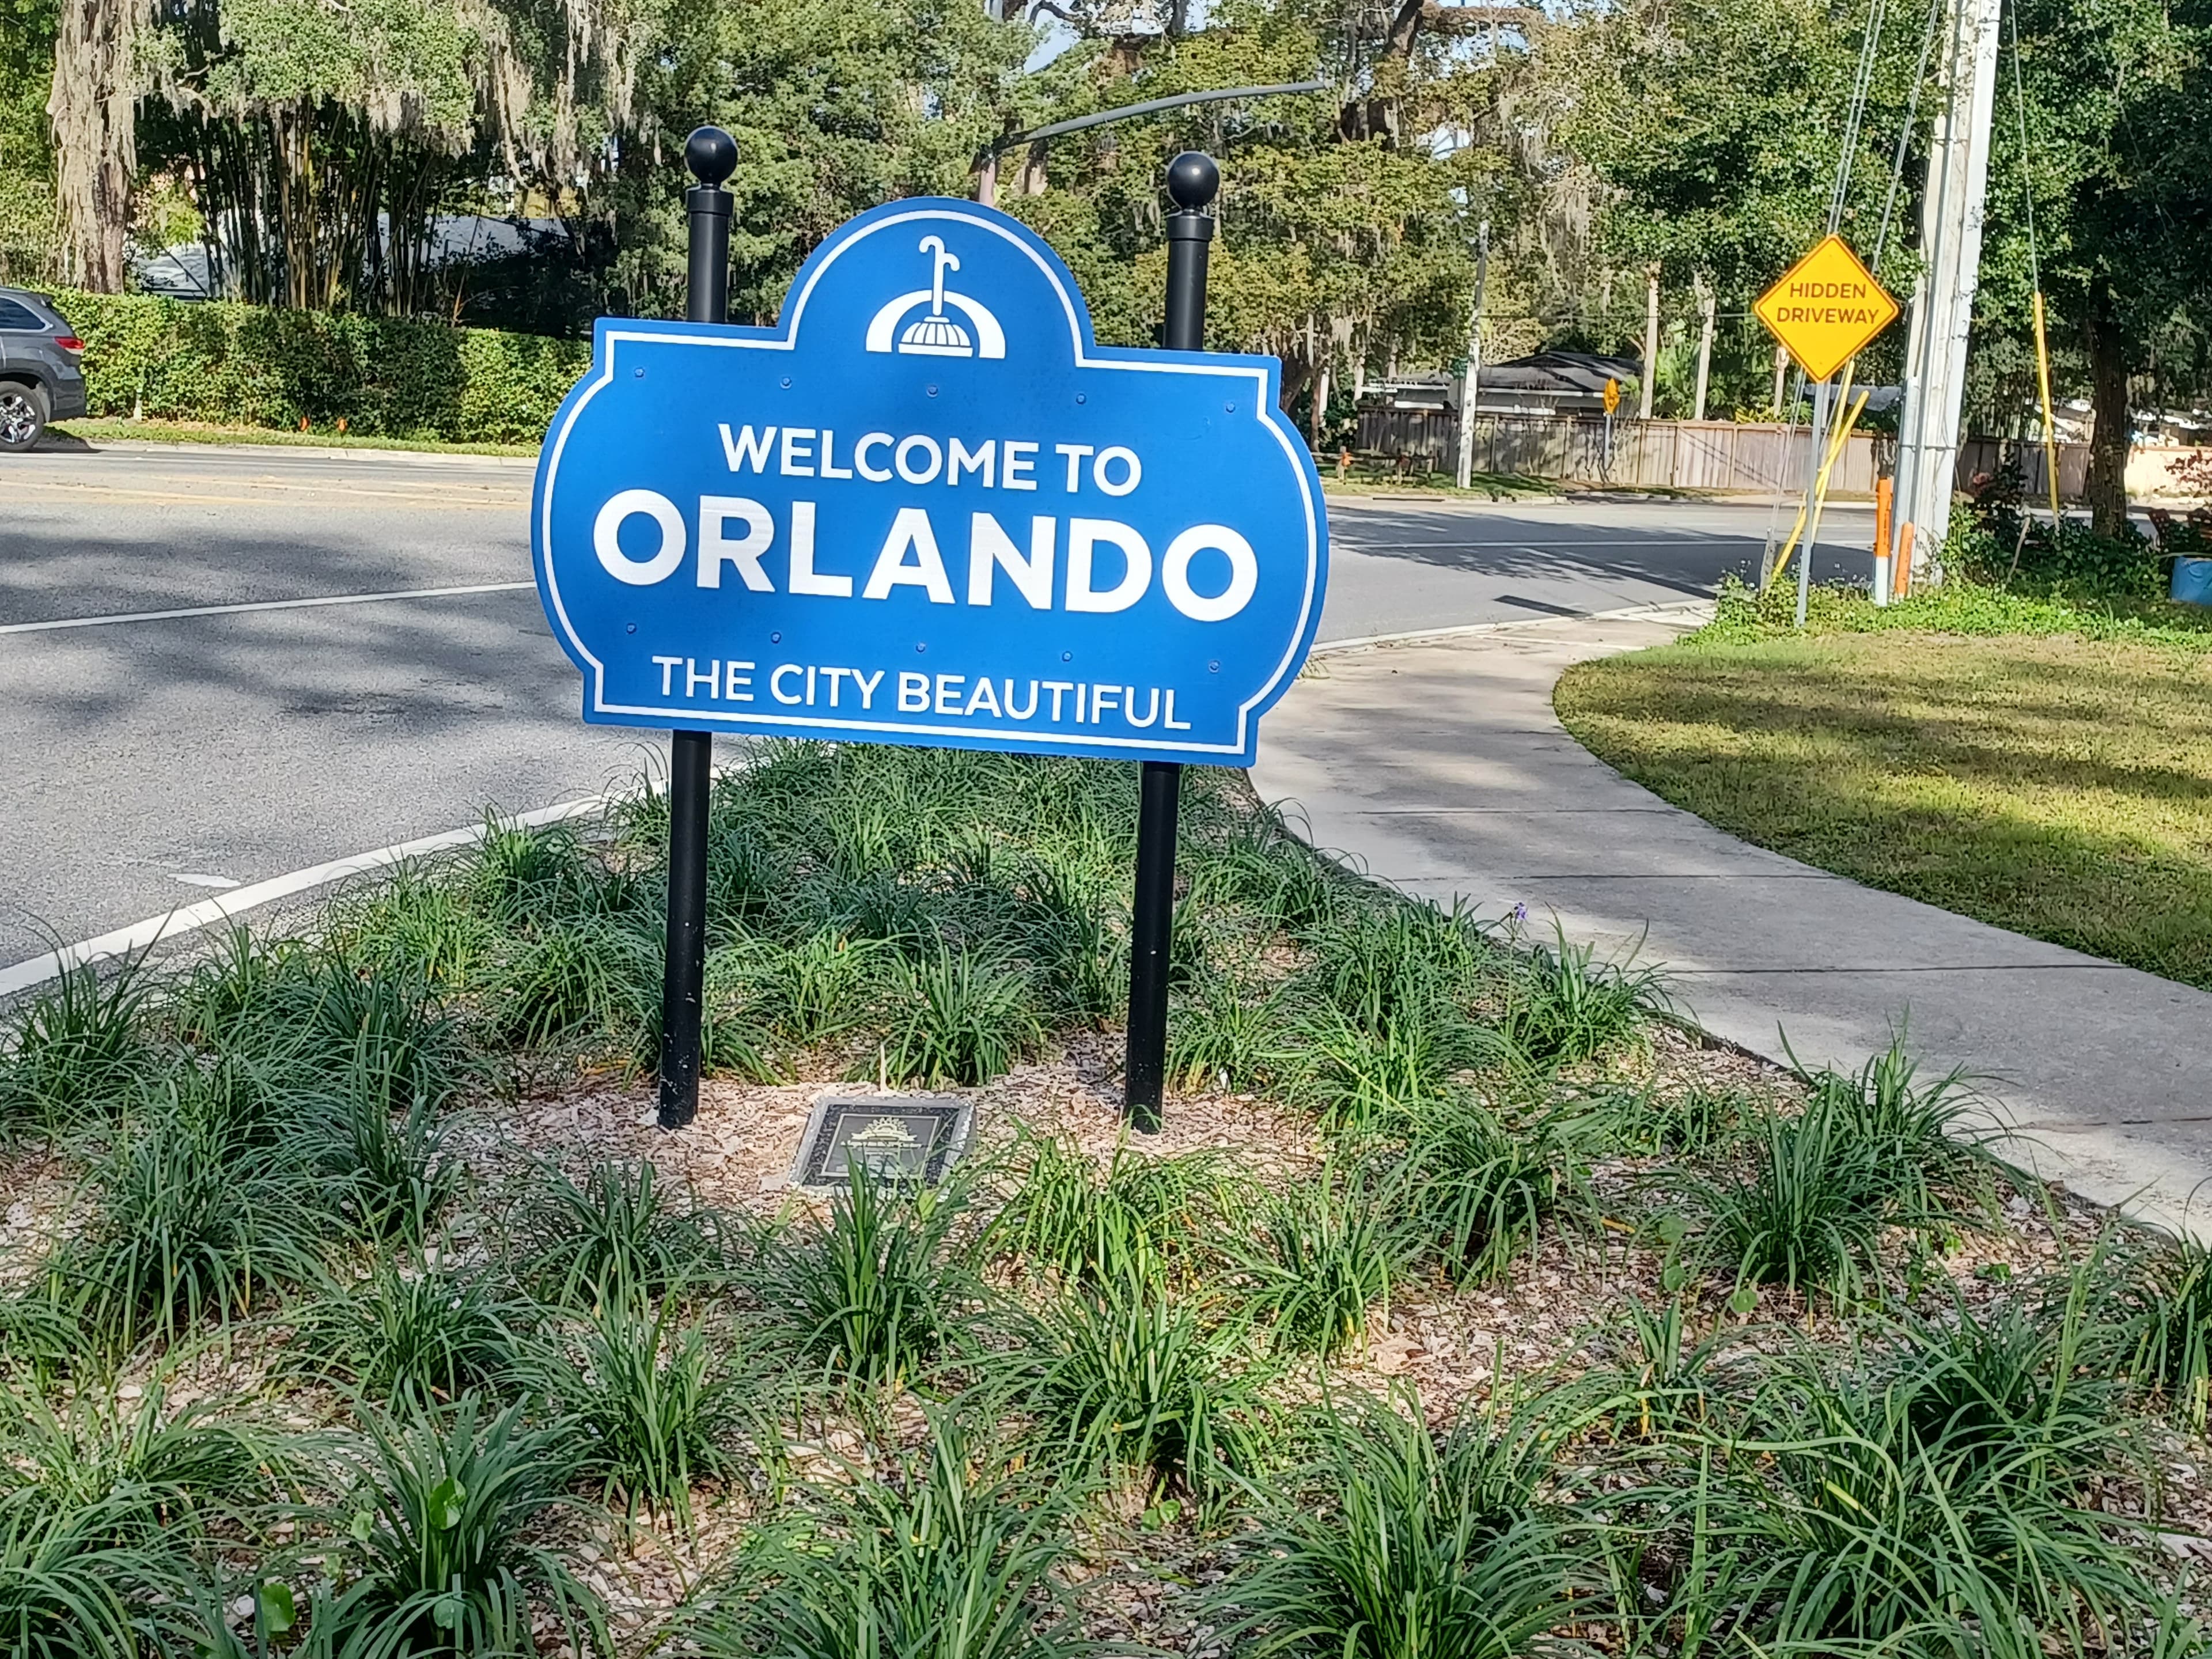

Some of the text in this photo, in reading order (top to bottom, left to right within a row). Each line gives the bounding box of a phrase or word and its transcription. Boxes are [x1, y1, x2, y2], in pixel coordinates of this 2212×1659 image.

[1777, 307, 1880, 324] DRIVEWAY
[1790, 282, 1866, 299] HIDDEN
[718, 423, 1142, 496] WELCOME TO
[593, 489, 1258, 622] ORLANDO
[652, 656, 1191, 729] THE CITY BEAUTIFUL
